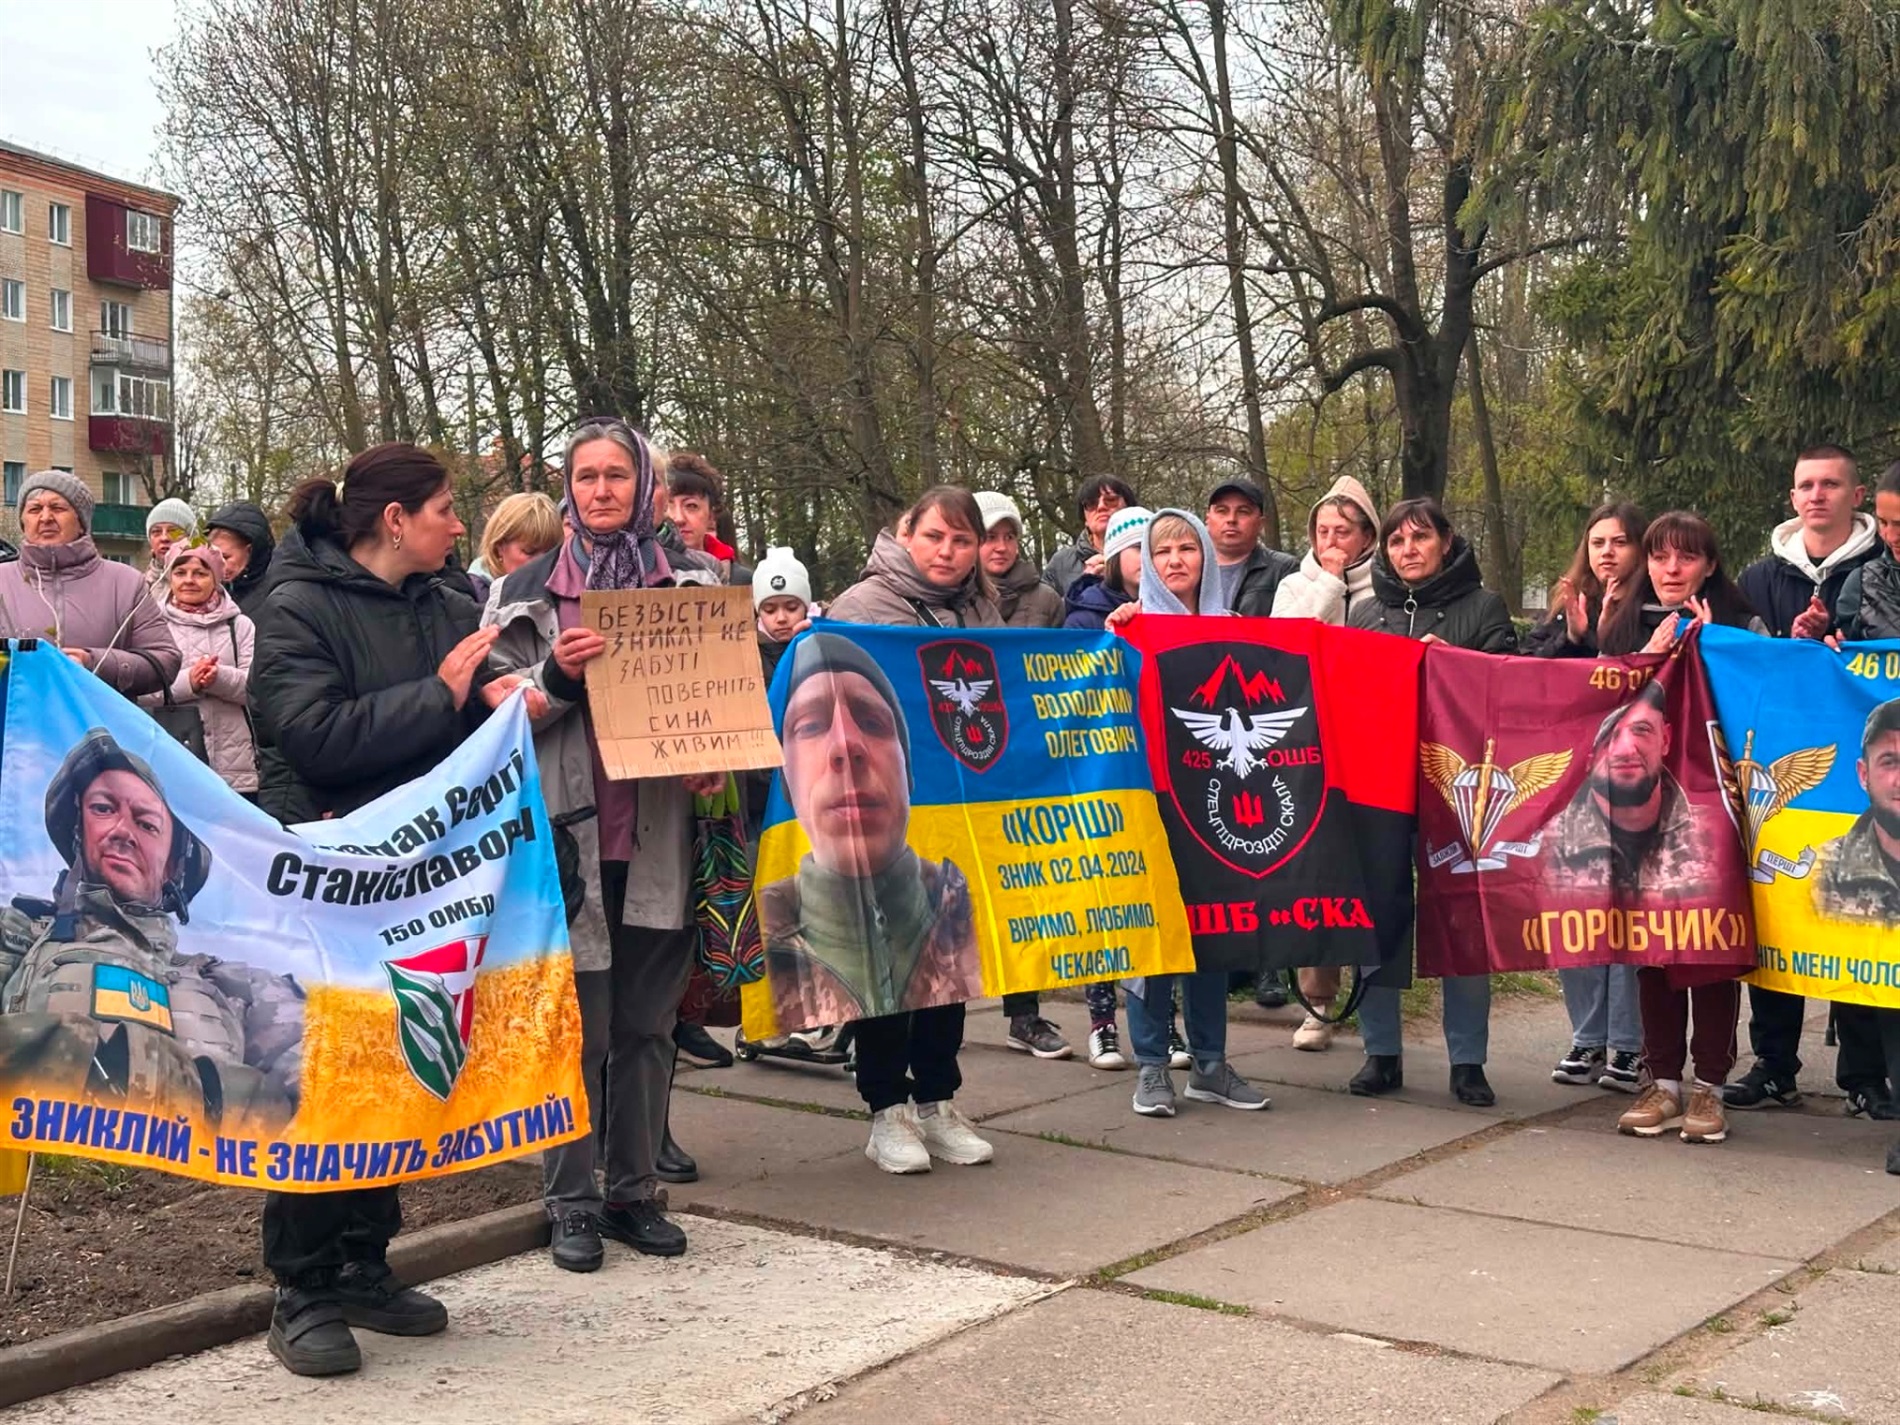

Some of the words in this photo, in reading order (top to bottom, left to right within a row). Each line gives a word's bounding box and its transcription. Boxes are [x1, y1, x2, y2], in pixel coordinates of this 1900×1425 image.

[721, 620, 748, 642] НЕ
[620, 651, 699, 684] ЗАБУТІ
[1023, 648, 1125, 682] КОРНІЙЧУ
[1589, 665, 1621, 690] 46
[1845, 652, 1880, 680] 46
[646, 677, 756, 706] ПОВЕРНІТЬ
[649, 708, 713, 733] СИНА
[651, 733, 741, 759] ЖИВИМ
[1045, 726, 1138, 758] ОЛЕГОВИЧ
[1266, 746, 1322, 768] ОШБ
[1182, 749, 1213, 770] 425
[1002, 799, 1125, 847] «КОРІШ»
[1207, 778, 1288, 854] СПЕЦПІДРОЗДІЛ
[1272, 774, 1295, 827] СКАЛА
[998, 860, 1048, 890] ЗНИК
[1049, 850, 1148, 884] 02.04.2024
[1766, 853, 1797, 874] ПЕРШІ
[378, 918, 426, 946] 150
[1008, 911, 1083, 944] ВІРИМО,
[1522, 906, 1746, 954] «ГОРОБЧИК»
[1051, 946, 1136, 981] ЧЕКАЄМО.
[1792, 950, 1841, 981] МЕНІ
[11, 1096, 192, 1164] ЗНИКЛИЙ
[215, 1135, 258, 1177] НЕ
[266, 1138, 428, 1182] ЗНАЧИТЬ
[431, 1092, 575, 1169] ЗАБУТИЙ!
